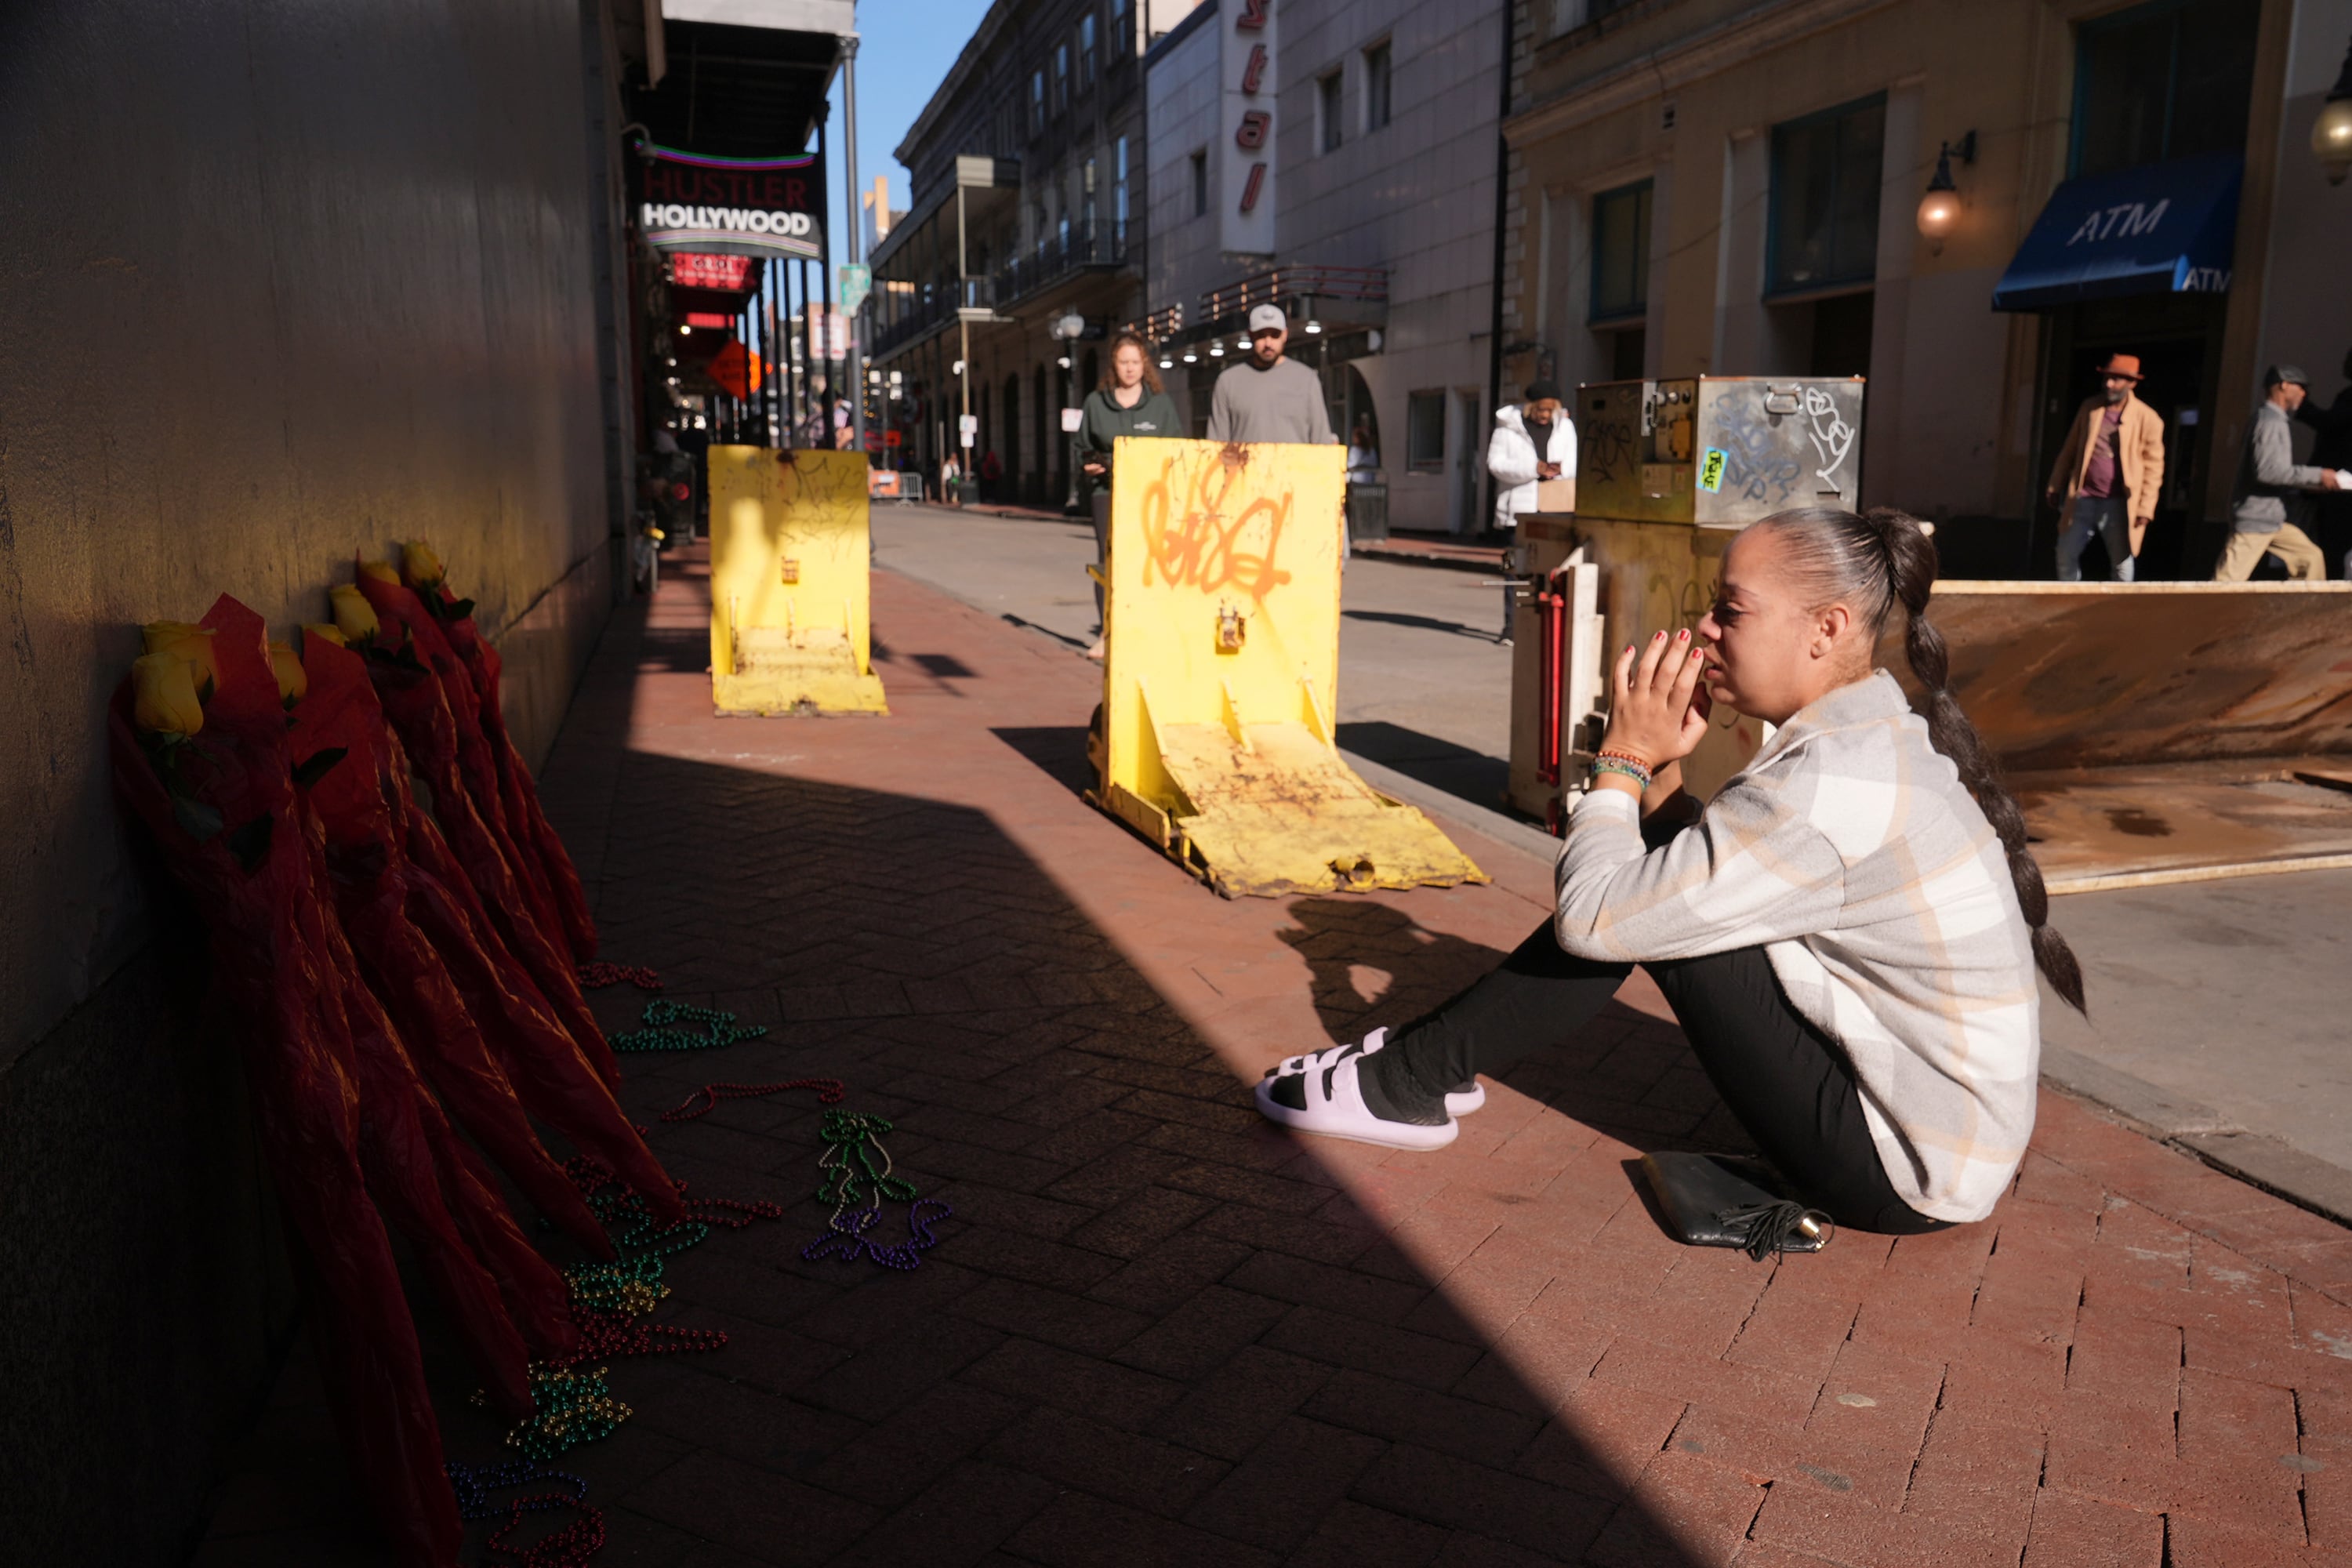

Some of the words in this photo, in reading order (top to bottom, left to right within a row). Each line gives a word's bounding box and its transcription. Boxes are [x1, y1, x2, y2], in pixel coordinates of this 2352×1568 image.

[644, 167, 808, 209] HUSTLER
[644, 203, 811, 235] HOLLYWOOD
[2065, 198, 2171, 247] ATM
[2182, 266, 2233, 293] ATM
